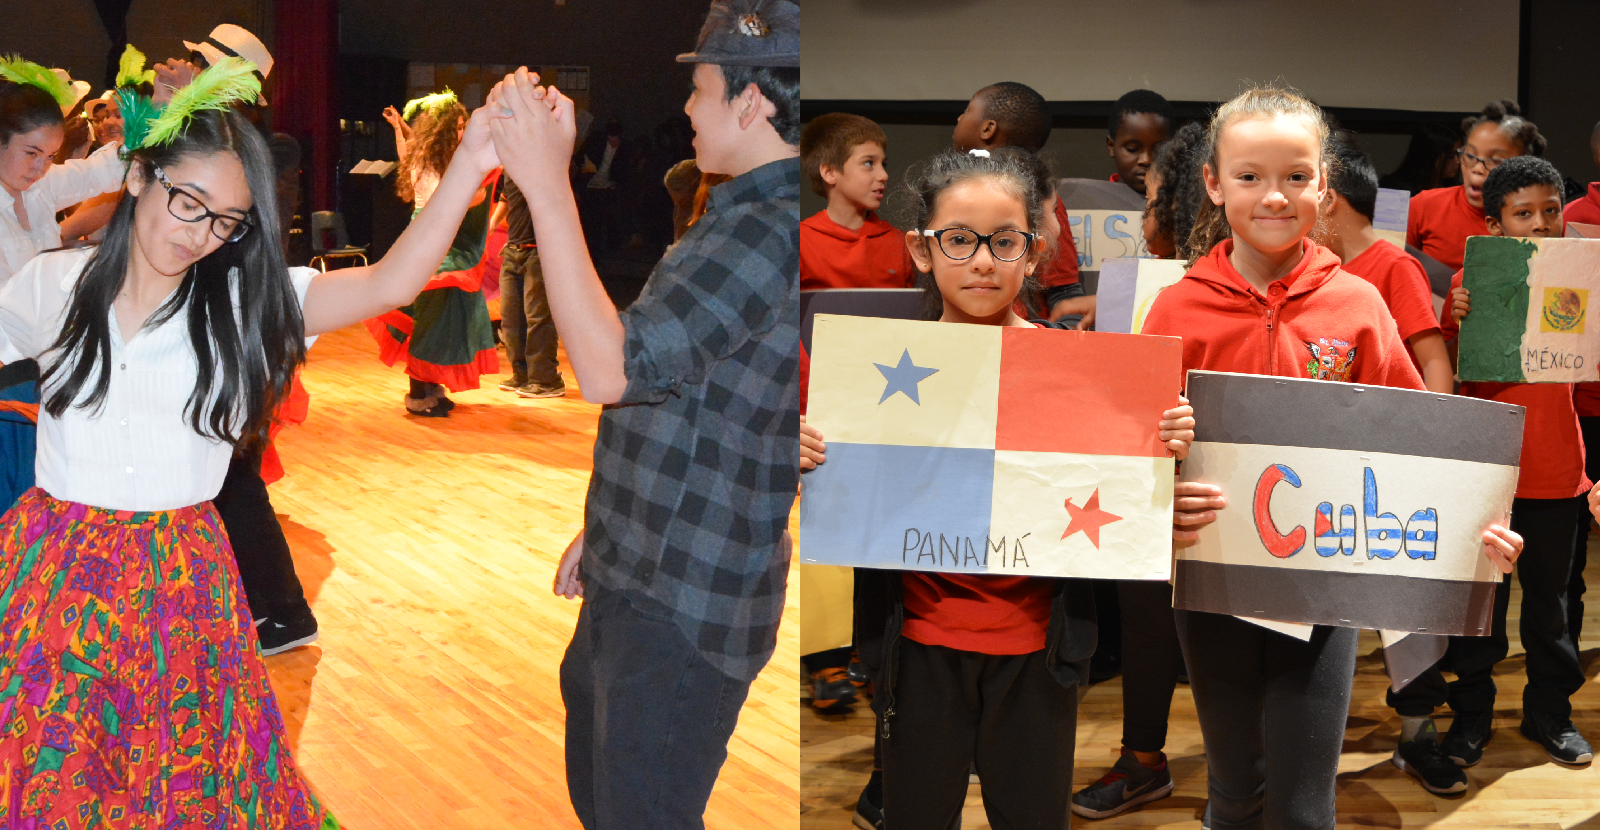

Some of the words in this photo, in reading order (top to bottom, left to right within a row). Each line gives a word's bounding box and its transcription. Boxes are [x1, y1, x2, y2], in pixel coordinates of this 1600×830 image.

[1525, 346, 1584, 372] MÉXICO
[1253, 463, 1439, 560] Cuba
[902, 527, 1032, 568] PANAMÁ
